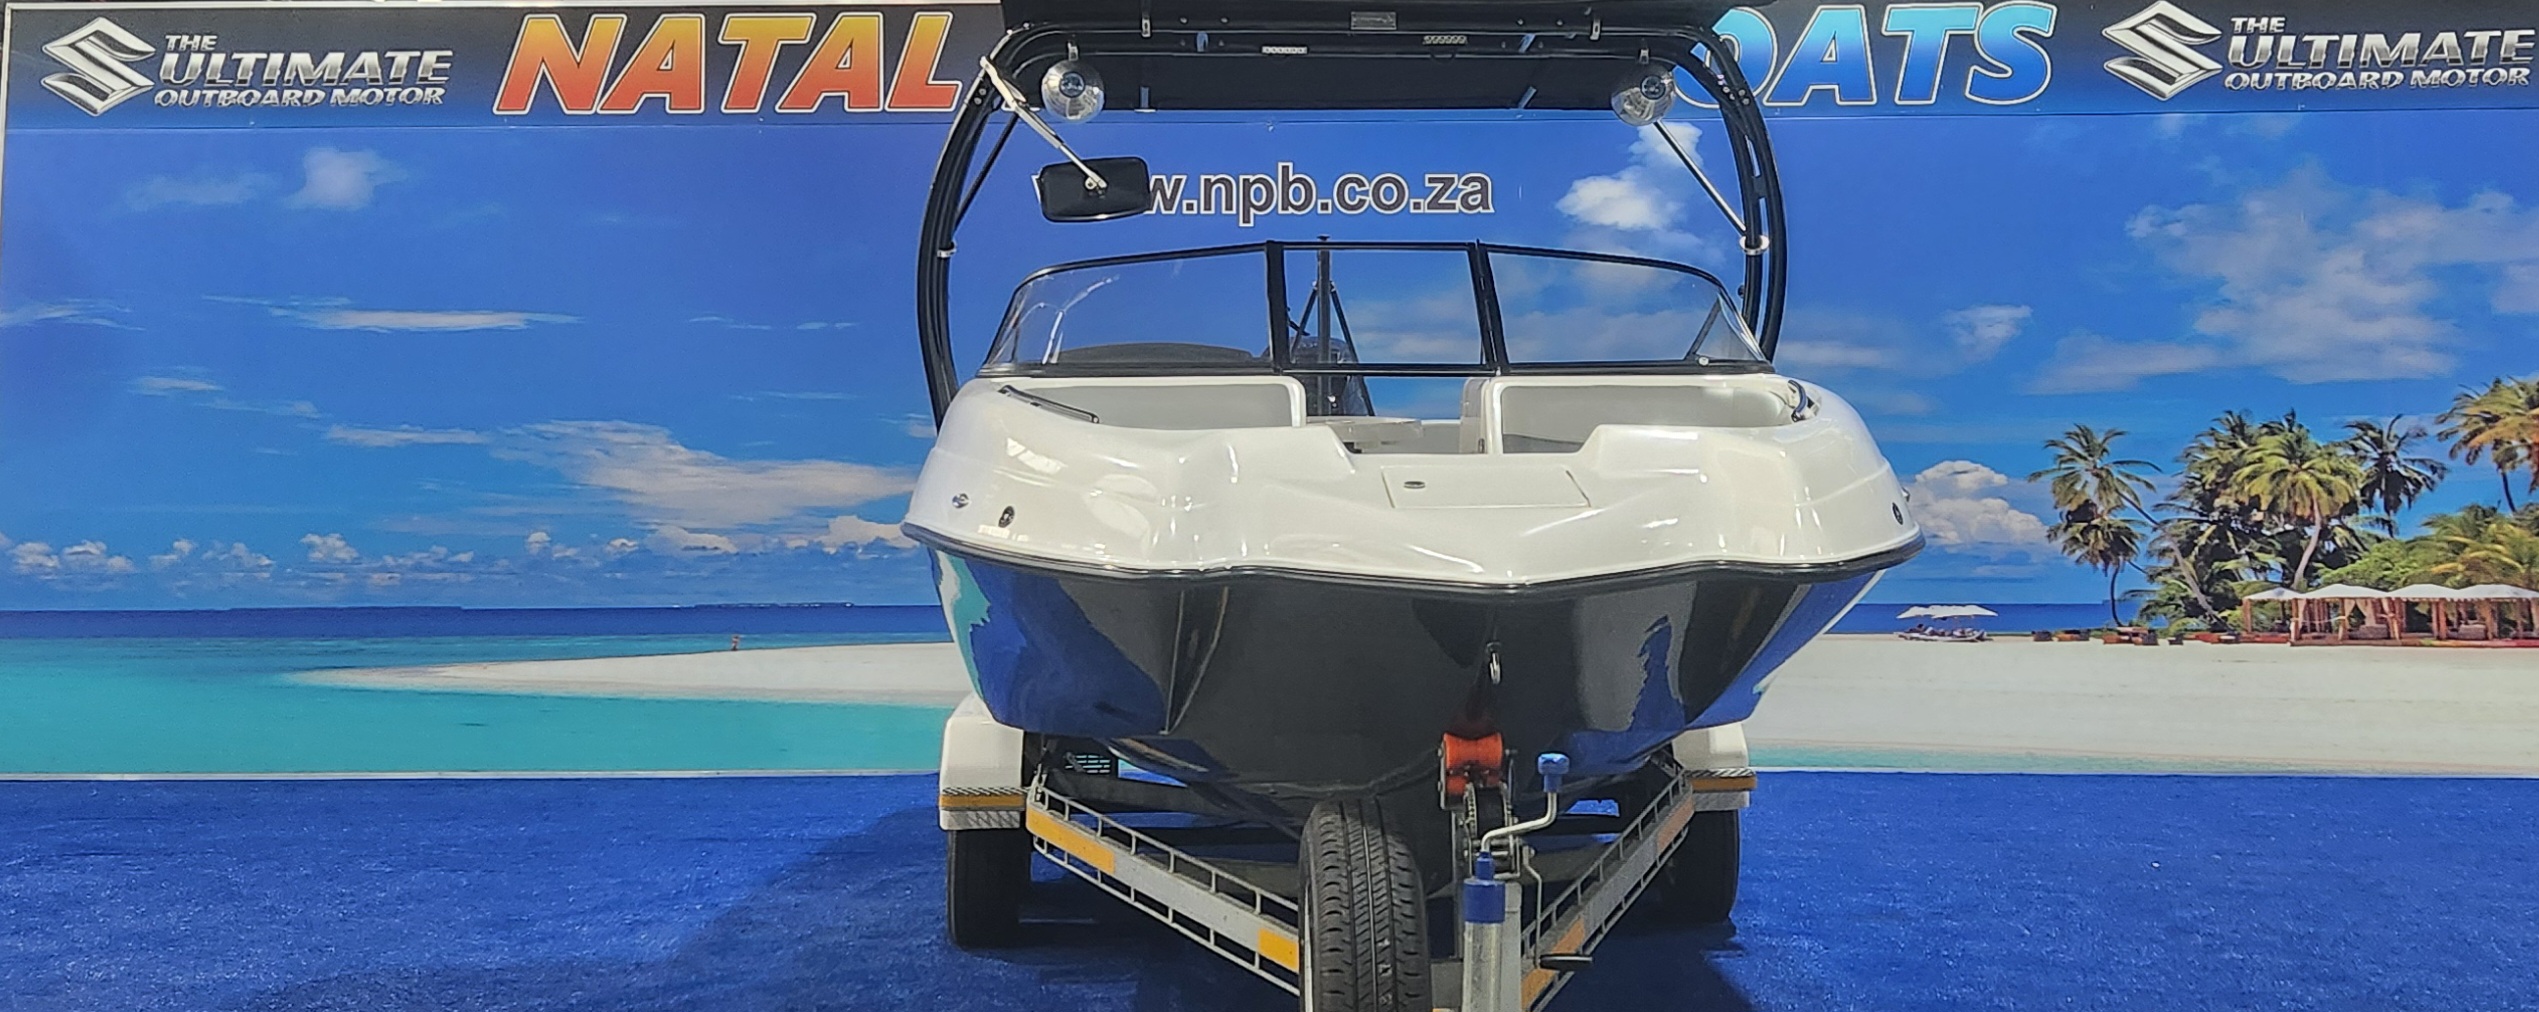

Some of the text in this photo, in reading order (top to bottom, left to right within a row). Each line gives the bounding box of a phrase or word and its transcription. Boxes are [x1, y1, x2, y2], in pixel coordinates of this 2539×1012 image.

[2230, 16, 2286, 34] THE
[164, 34, 217, 51] THE
[2227, 29, 2536, 69] ULTIMATE
[158, 50, 453, 86] ULTIMATE
[493, 13, 962, 114] NATAL
[2223, 67, 2531, 91] OUTBOARD MOTOR
[154, 86, 445, 107] OUTBOARD MOTOR
[1031, 162, 1494, 227] w.npb.co.za
